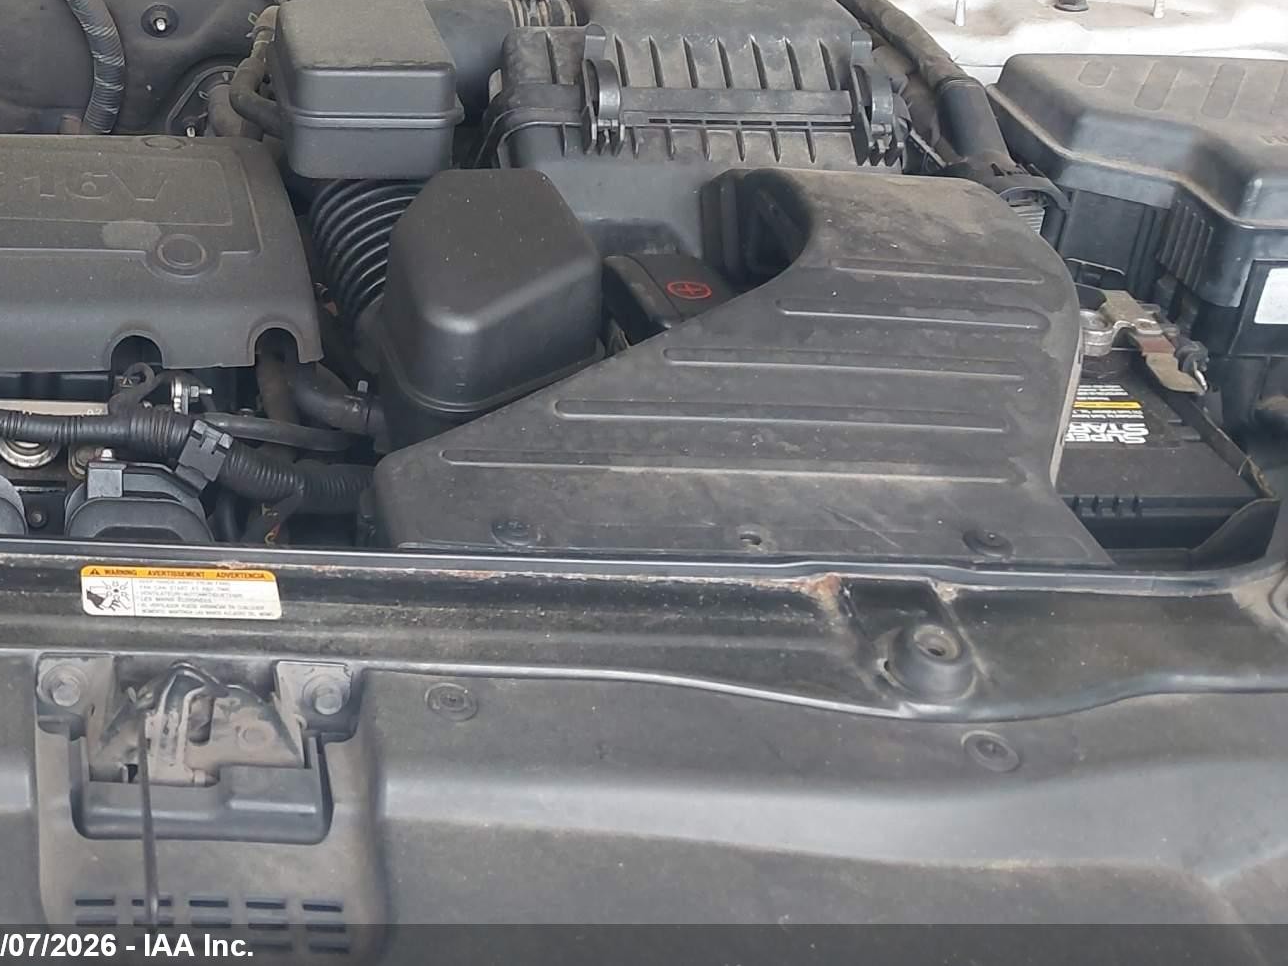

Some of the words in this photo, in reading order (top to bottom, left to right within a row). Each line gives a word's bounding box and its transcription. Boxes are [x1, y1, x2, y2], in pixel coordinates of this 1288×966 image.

[22, 168, 171, 204] 16V
[104, 569, 137, 577] WARNING
[146, 570, 205, 578] AVERTISSEMENT
[215, 571, 265, 580] ADVERTENCIA
